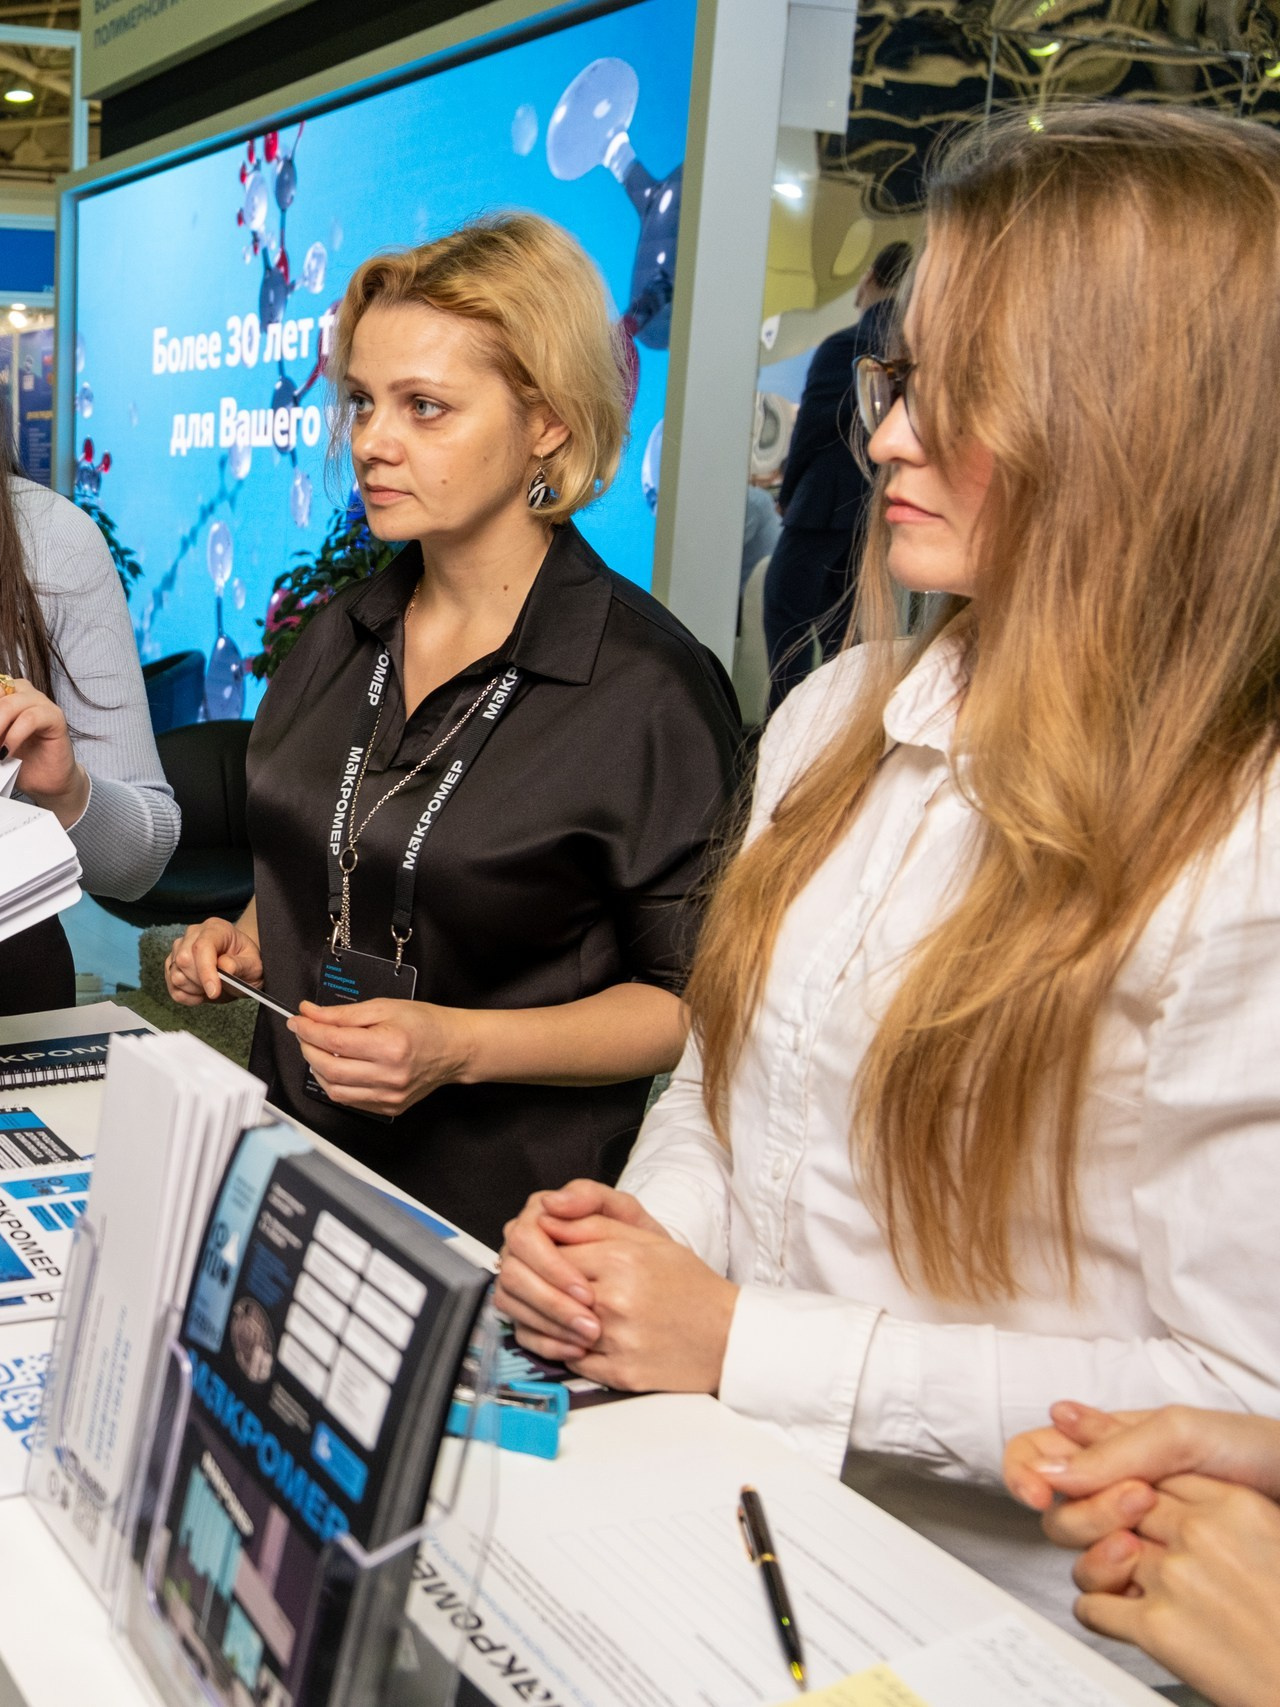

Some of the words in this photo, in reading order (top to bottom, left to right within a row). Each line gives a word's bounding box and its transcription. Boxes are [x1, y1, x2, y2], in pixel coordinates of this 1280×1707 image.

[152, 326, 222, 375] Более
[225, 313, 261, 369] 30
[263, 317, 314, 363] лет
[170, 411, 215, 457] для
[219, 397, 320, 448] Вашего
